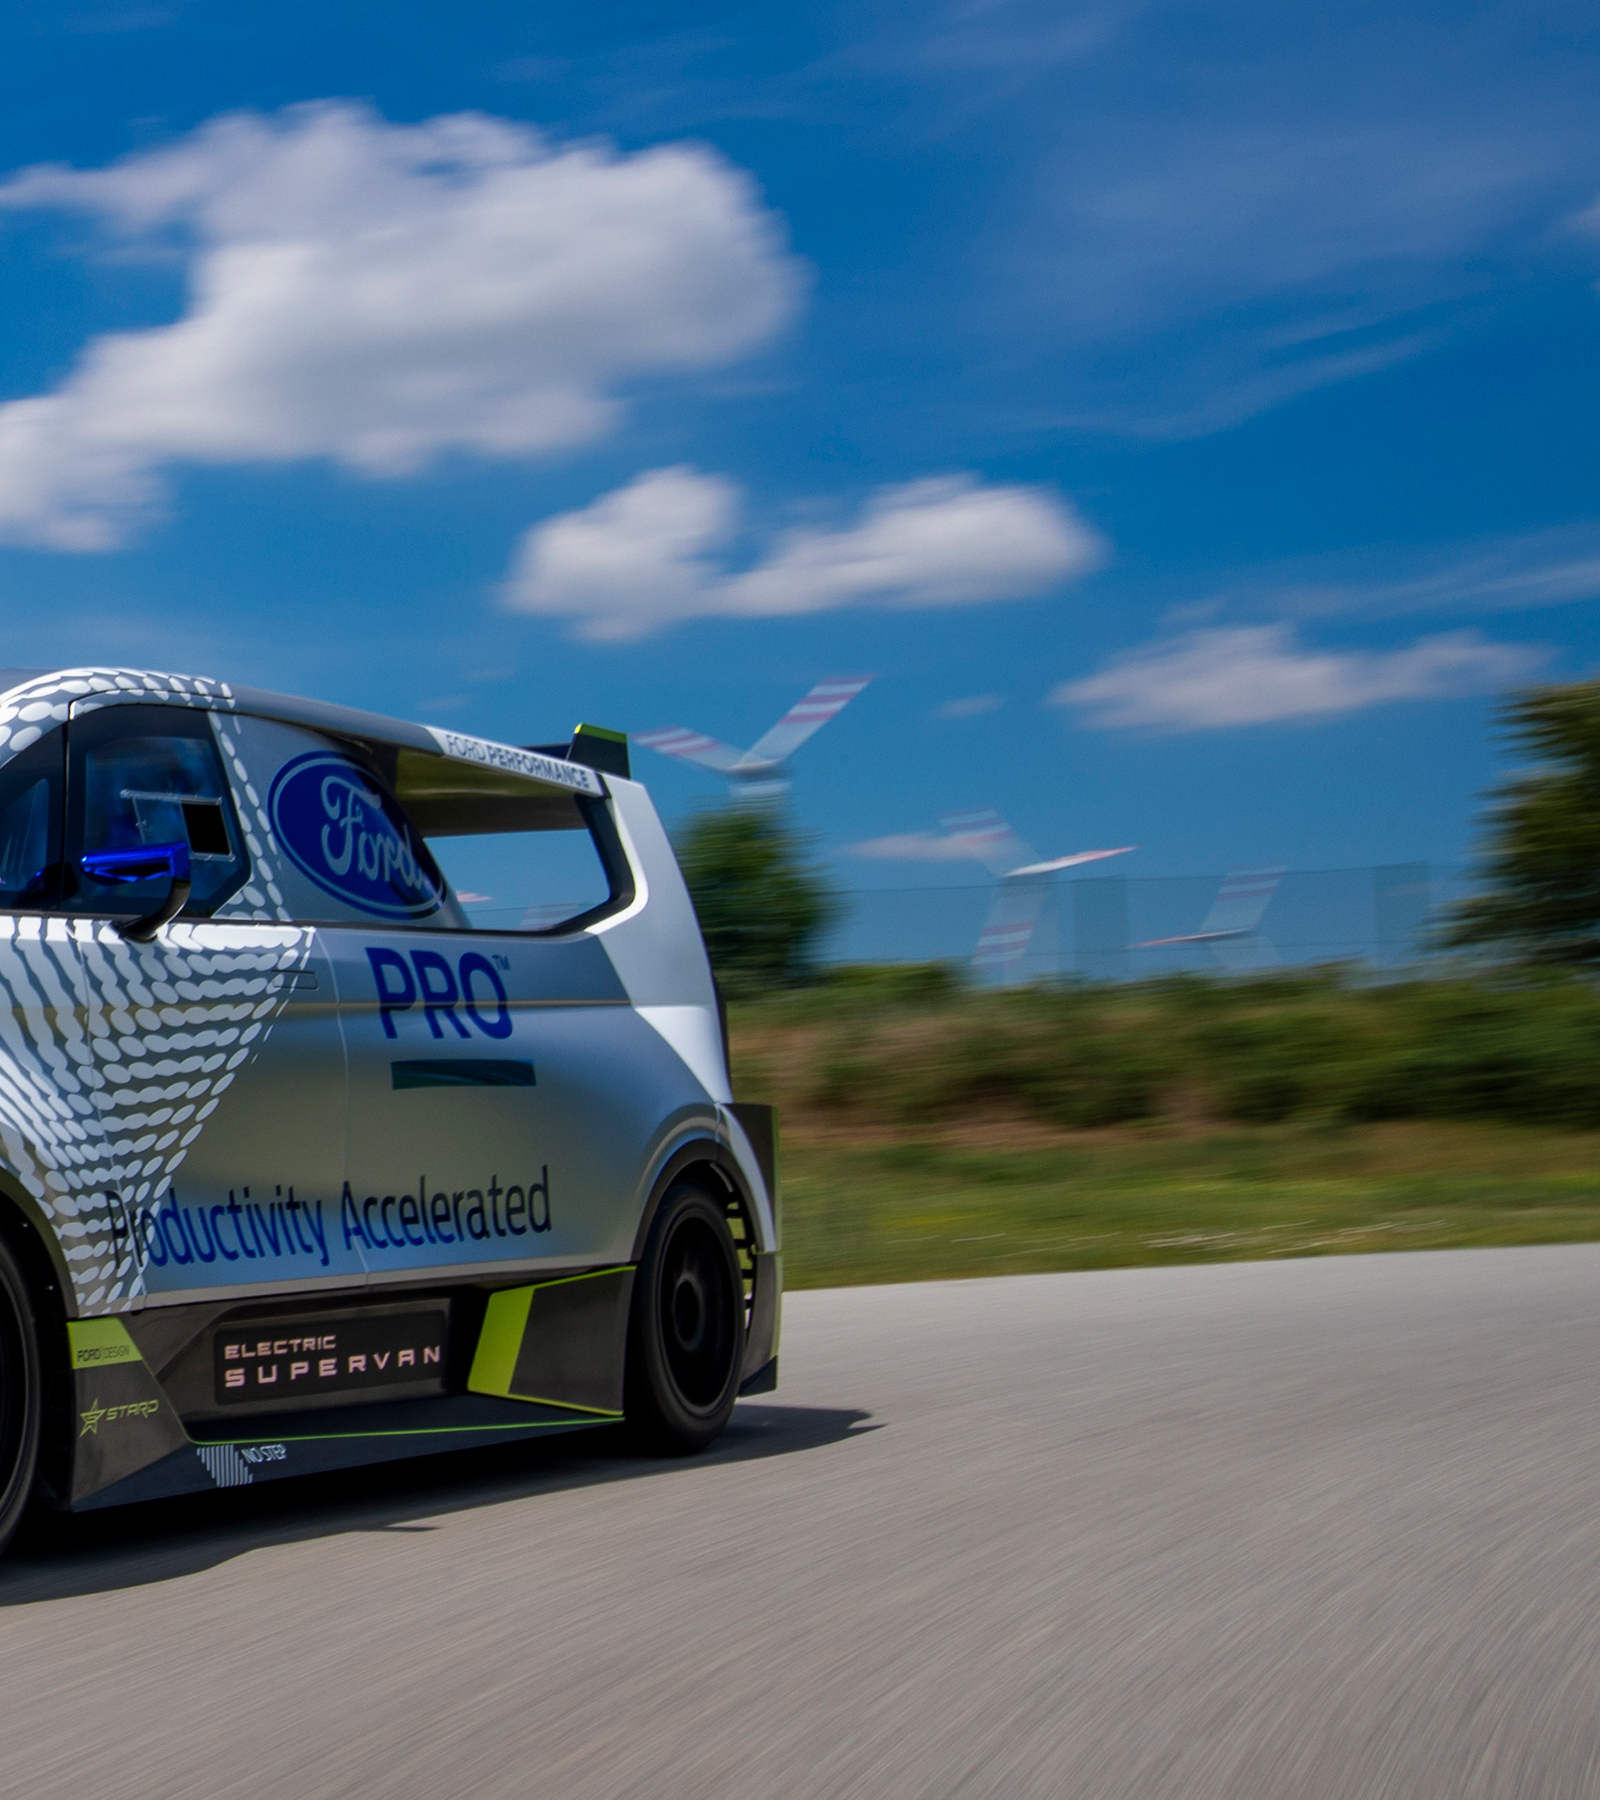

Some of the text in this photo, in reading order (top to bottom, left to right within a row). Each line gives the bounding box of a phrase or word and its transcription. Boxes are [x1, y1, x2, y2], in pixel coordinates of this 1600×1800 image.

[445, 733, 591, 789] FORD PERFORMANCE
[320, 774, 427, 891] Ford
[103, 1163, 553, 1268] Productivity Accelerated
[224, 1334, 337, 1360] ELECTRIC
[224, 1345, 442, 1388] SUPERVAN
[105, 1399, 159, 1421] STARD
[241, 1443, 287, 1464] NO STEP
